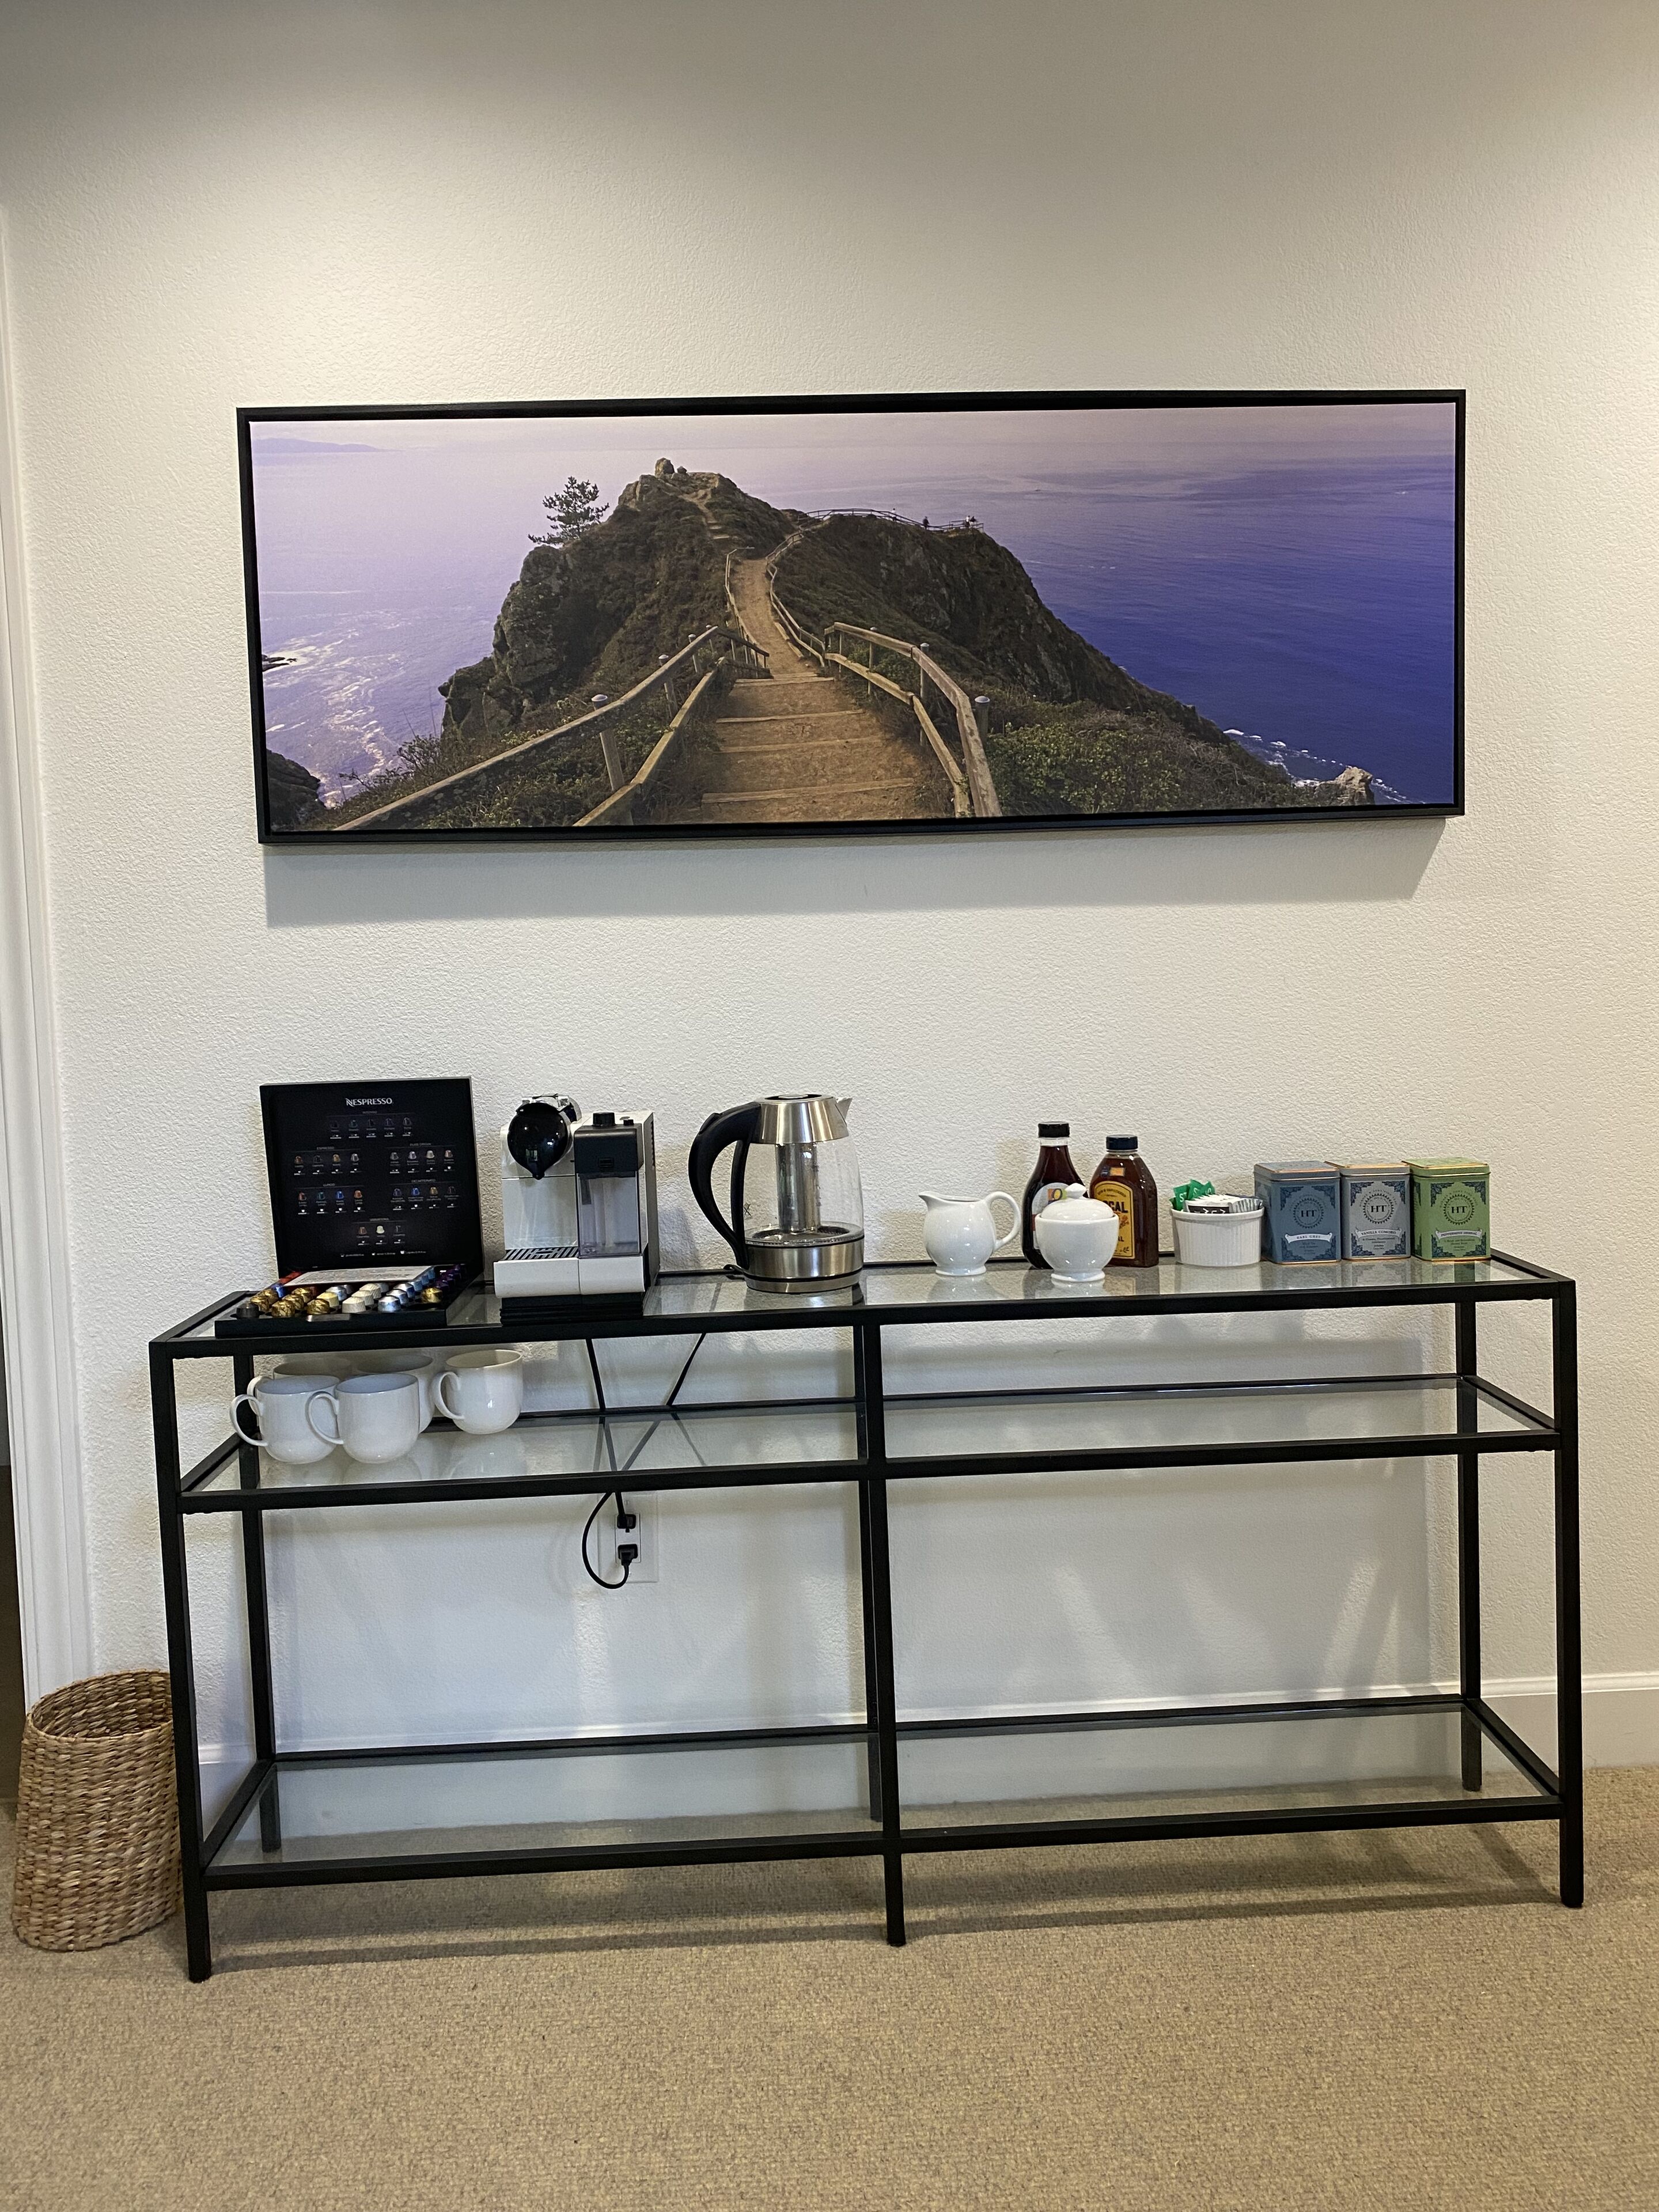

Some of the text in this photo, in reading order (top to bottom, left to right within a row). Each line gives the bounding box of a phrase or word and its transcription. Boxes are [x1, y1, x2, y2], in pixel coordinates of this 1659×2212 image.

[345, 1097, 393, 1107] NESPRESSO
[1301, 1209, 1317, 1217] HT
[1371, 1205, 1387, 1213] HT
[1451, 1206, 1468, 1214] HT
